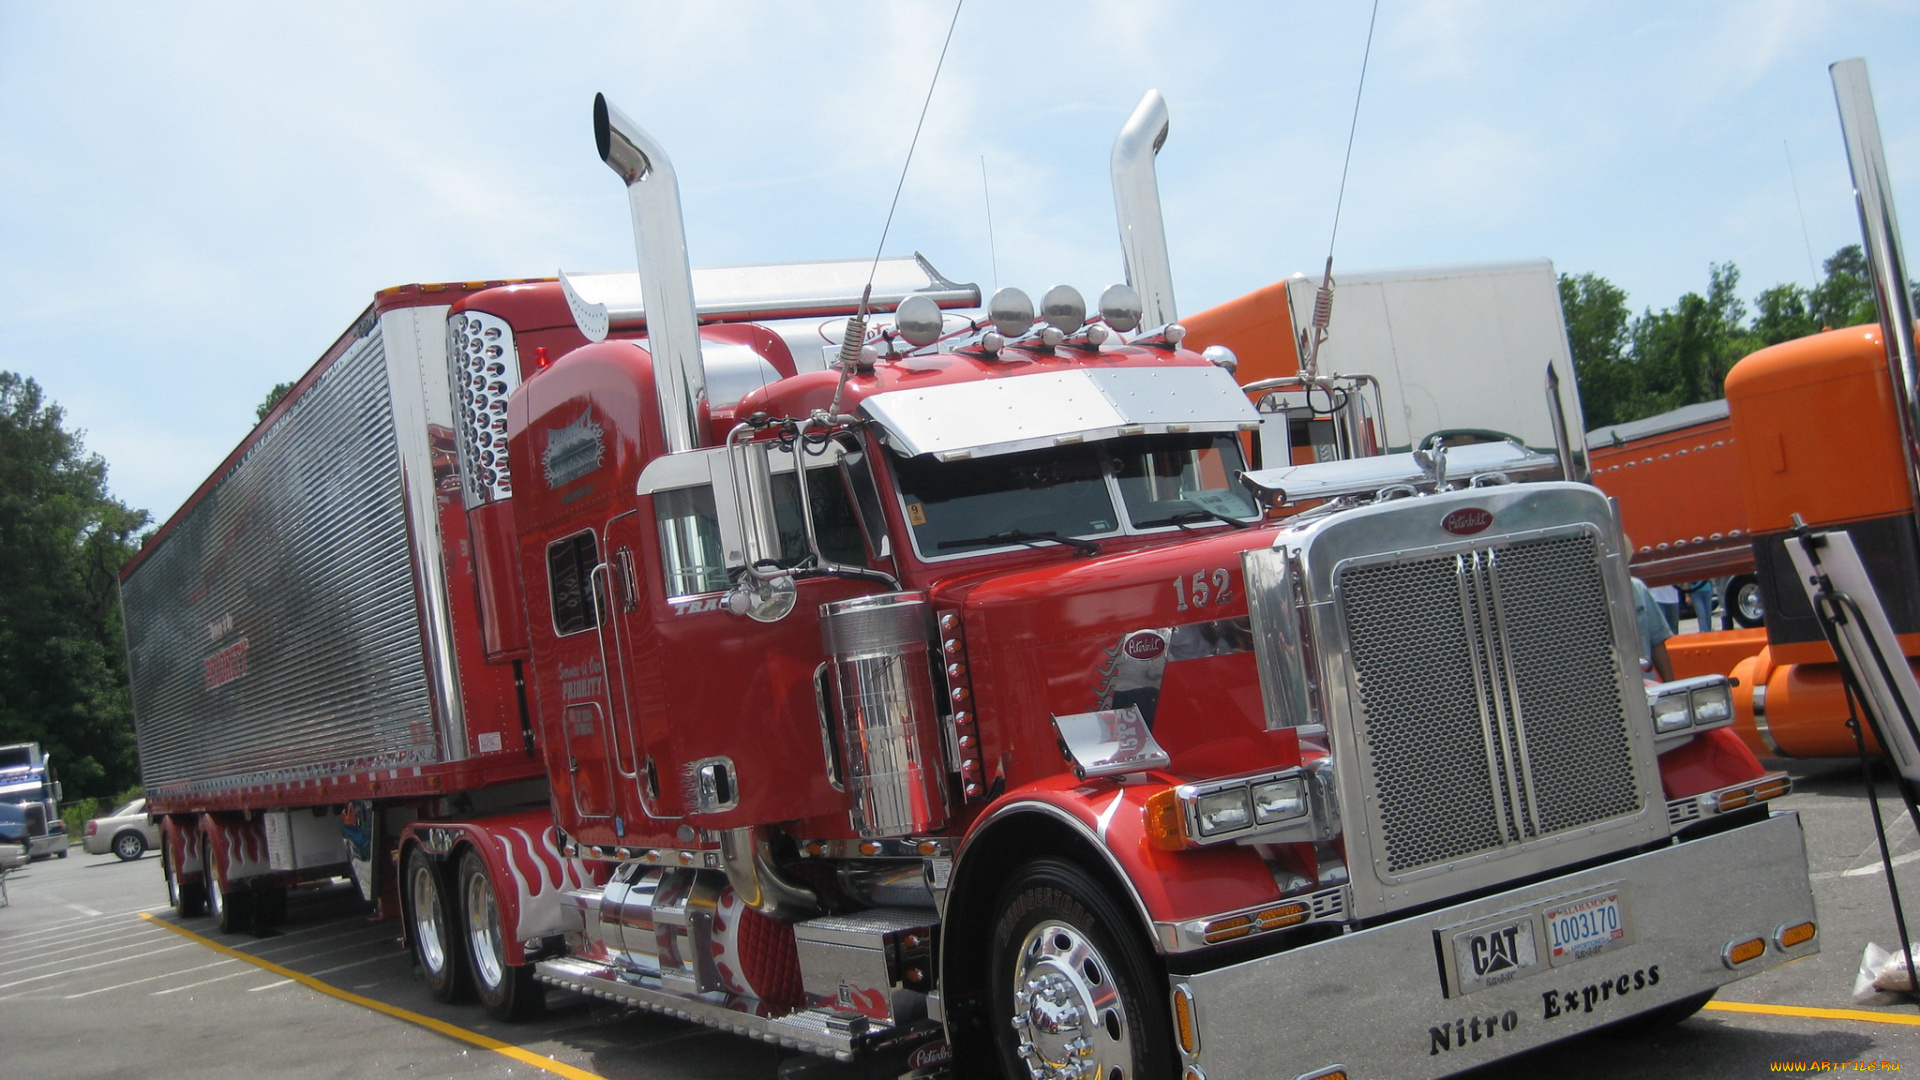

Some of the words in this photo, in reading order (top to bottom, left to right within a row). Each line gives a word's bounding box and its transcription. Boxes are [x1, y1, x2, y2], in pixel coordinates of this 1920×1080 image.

[911, 504, 919, 515] 9
[1448, 512, 1488, 531] Peterbilt
[1173, 568, 1233, 612] 152
[1128, 635, 1162, 656] Peterbilt
[563, 677, 602, 700] PRIORITY
[999, 888, 1095, 947] BRIDGESTONE
[1563, 900, 1605, 916] ALABAMA
[1552, 905, 1618, 948] 1003170
[1471, 927, 1519, 976] CAT
[1429, 1009, 1519, 1056] Nitro
[1541, 964, 1661, 1020] Express
[916, 1045, 953, 1068] Peterbi
